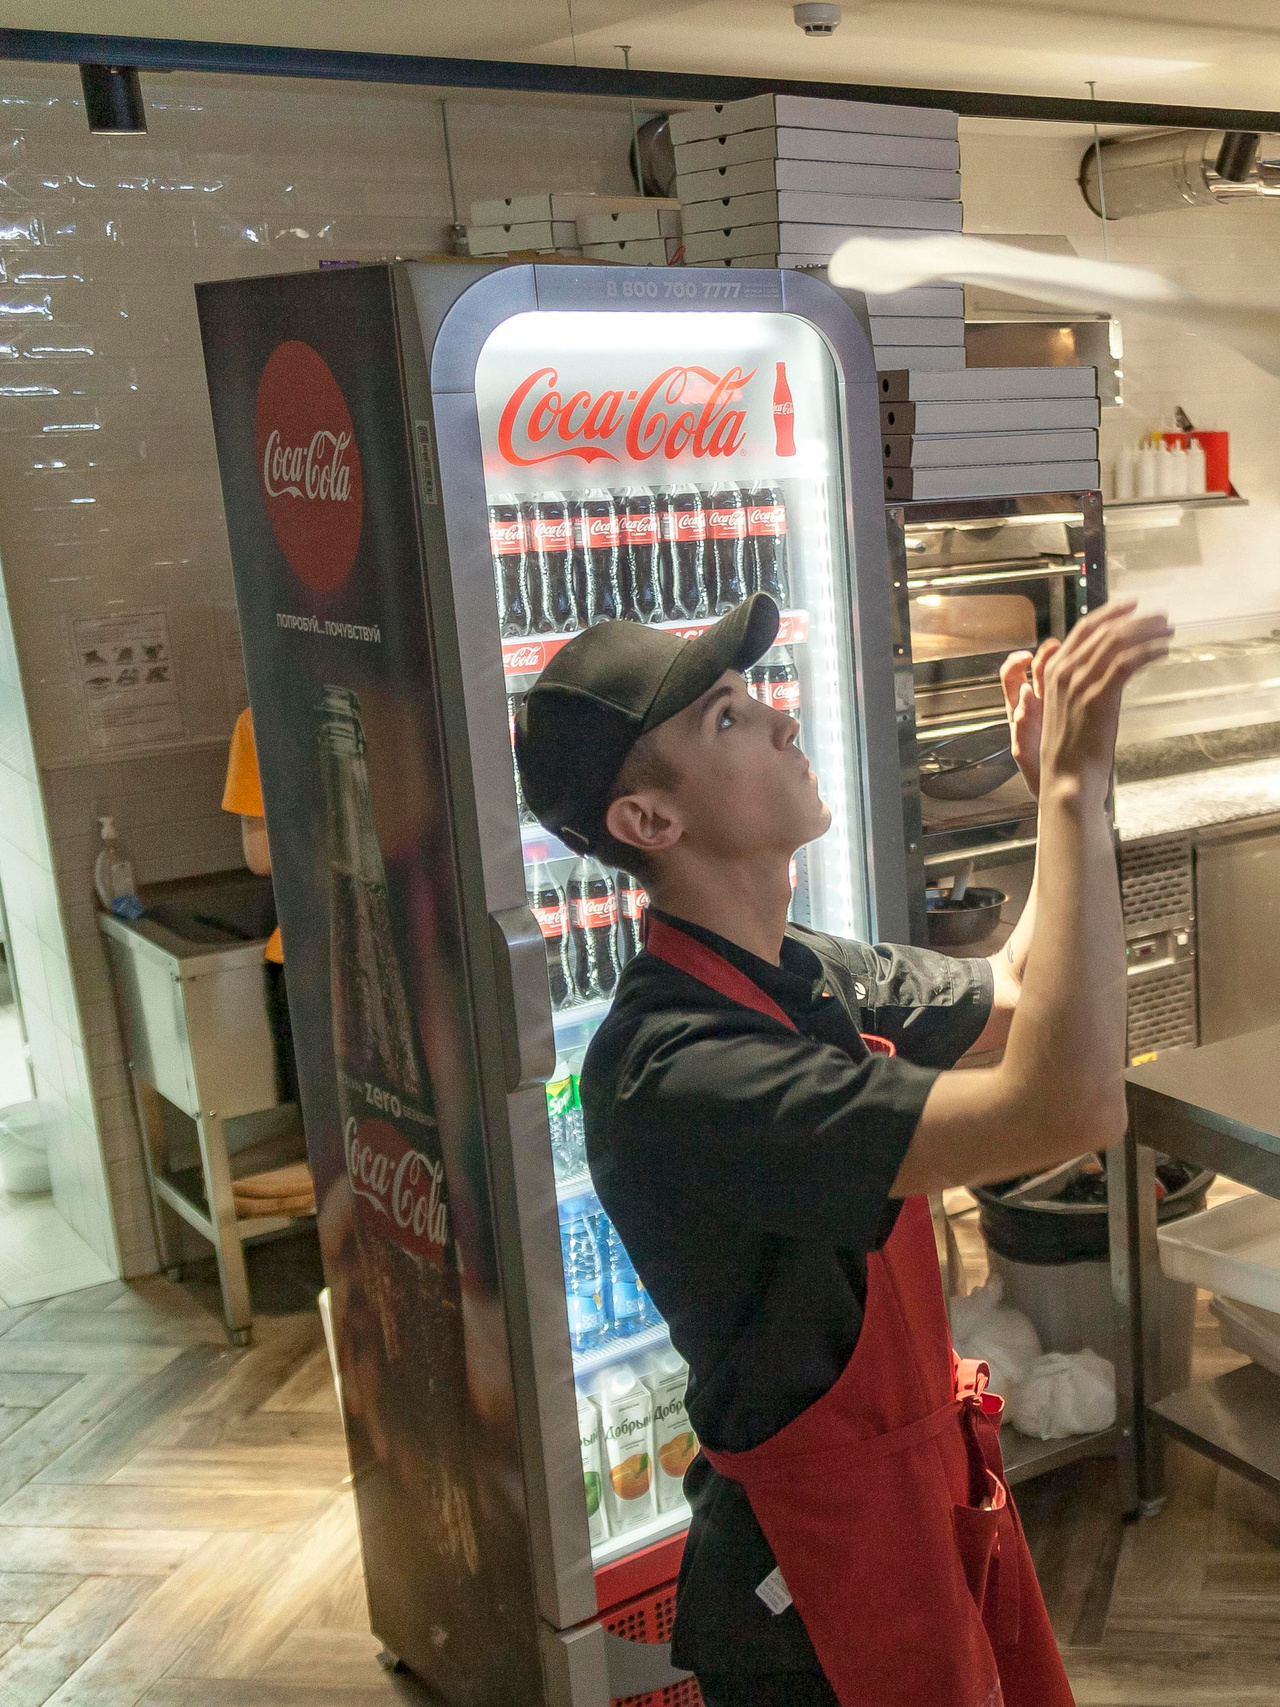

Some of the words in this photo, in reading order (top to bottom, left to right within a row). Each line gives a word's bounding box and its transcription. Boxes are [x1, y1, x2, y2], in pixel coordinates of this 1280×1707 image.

[606, 281, 618, 297] 8
[622, 281, 659, 298] 800
[664, 282, 698, 298] 700
[702, 282, 742, 298] 7777
[498, 366, 759, 467] Coca-Cola
[264, 428, 352, 502] Coca-Cola
[344, 1116, 448, 1246] Coca-Cola
